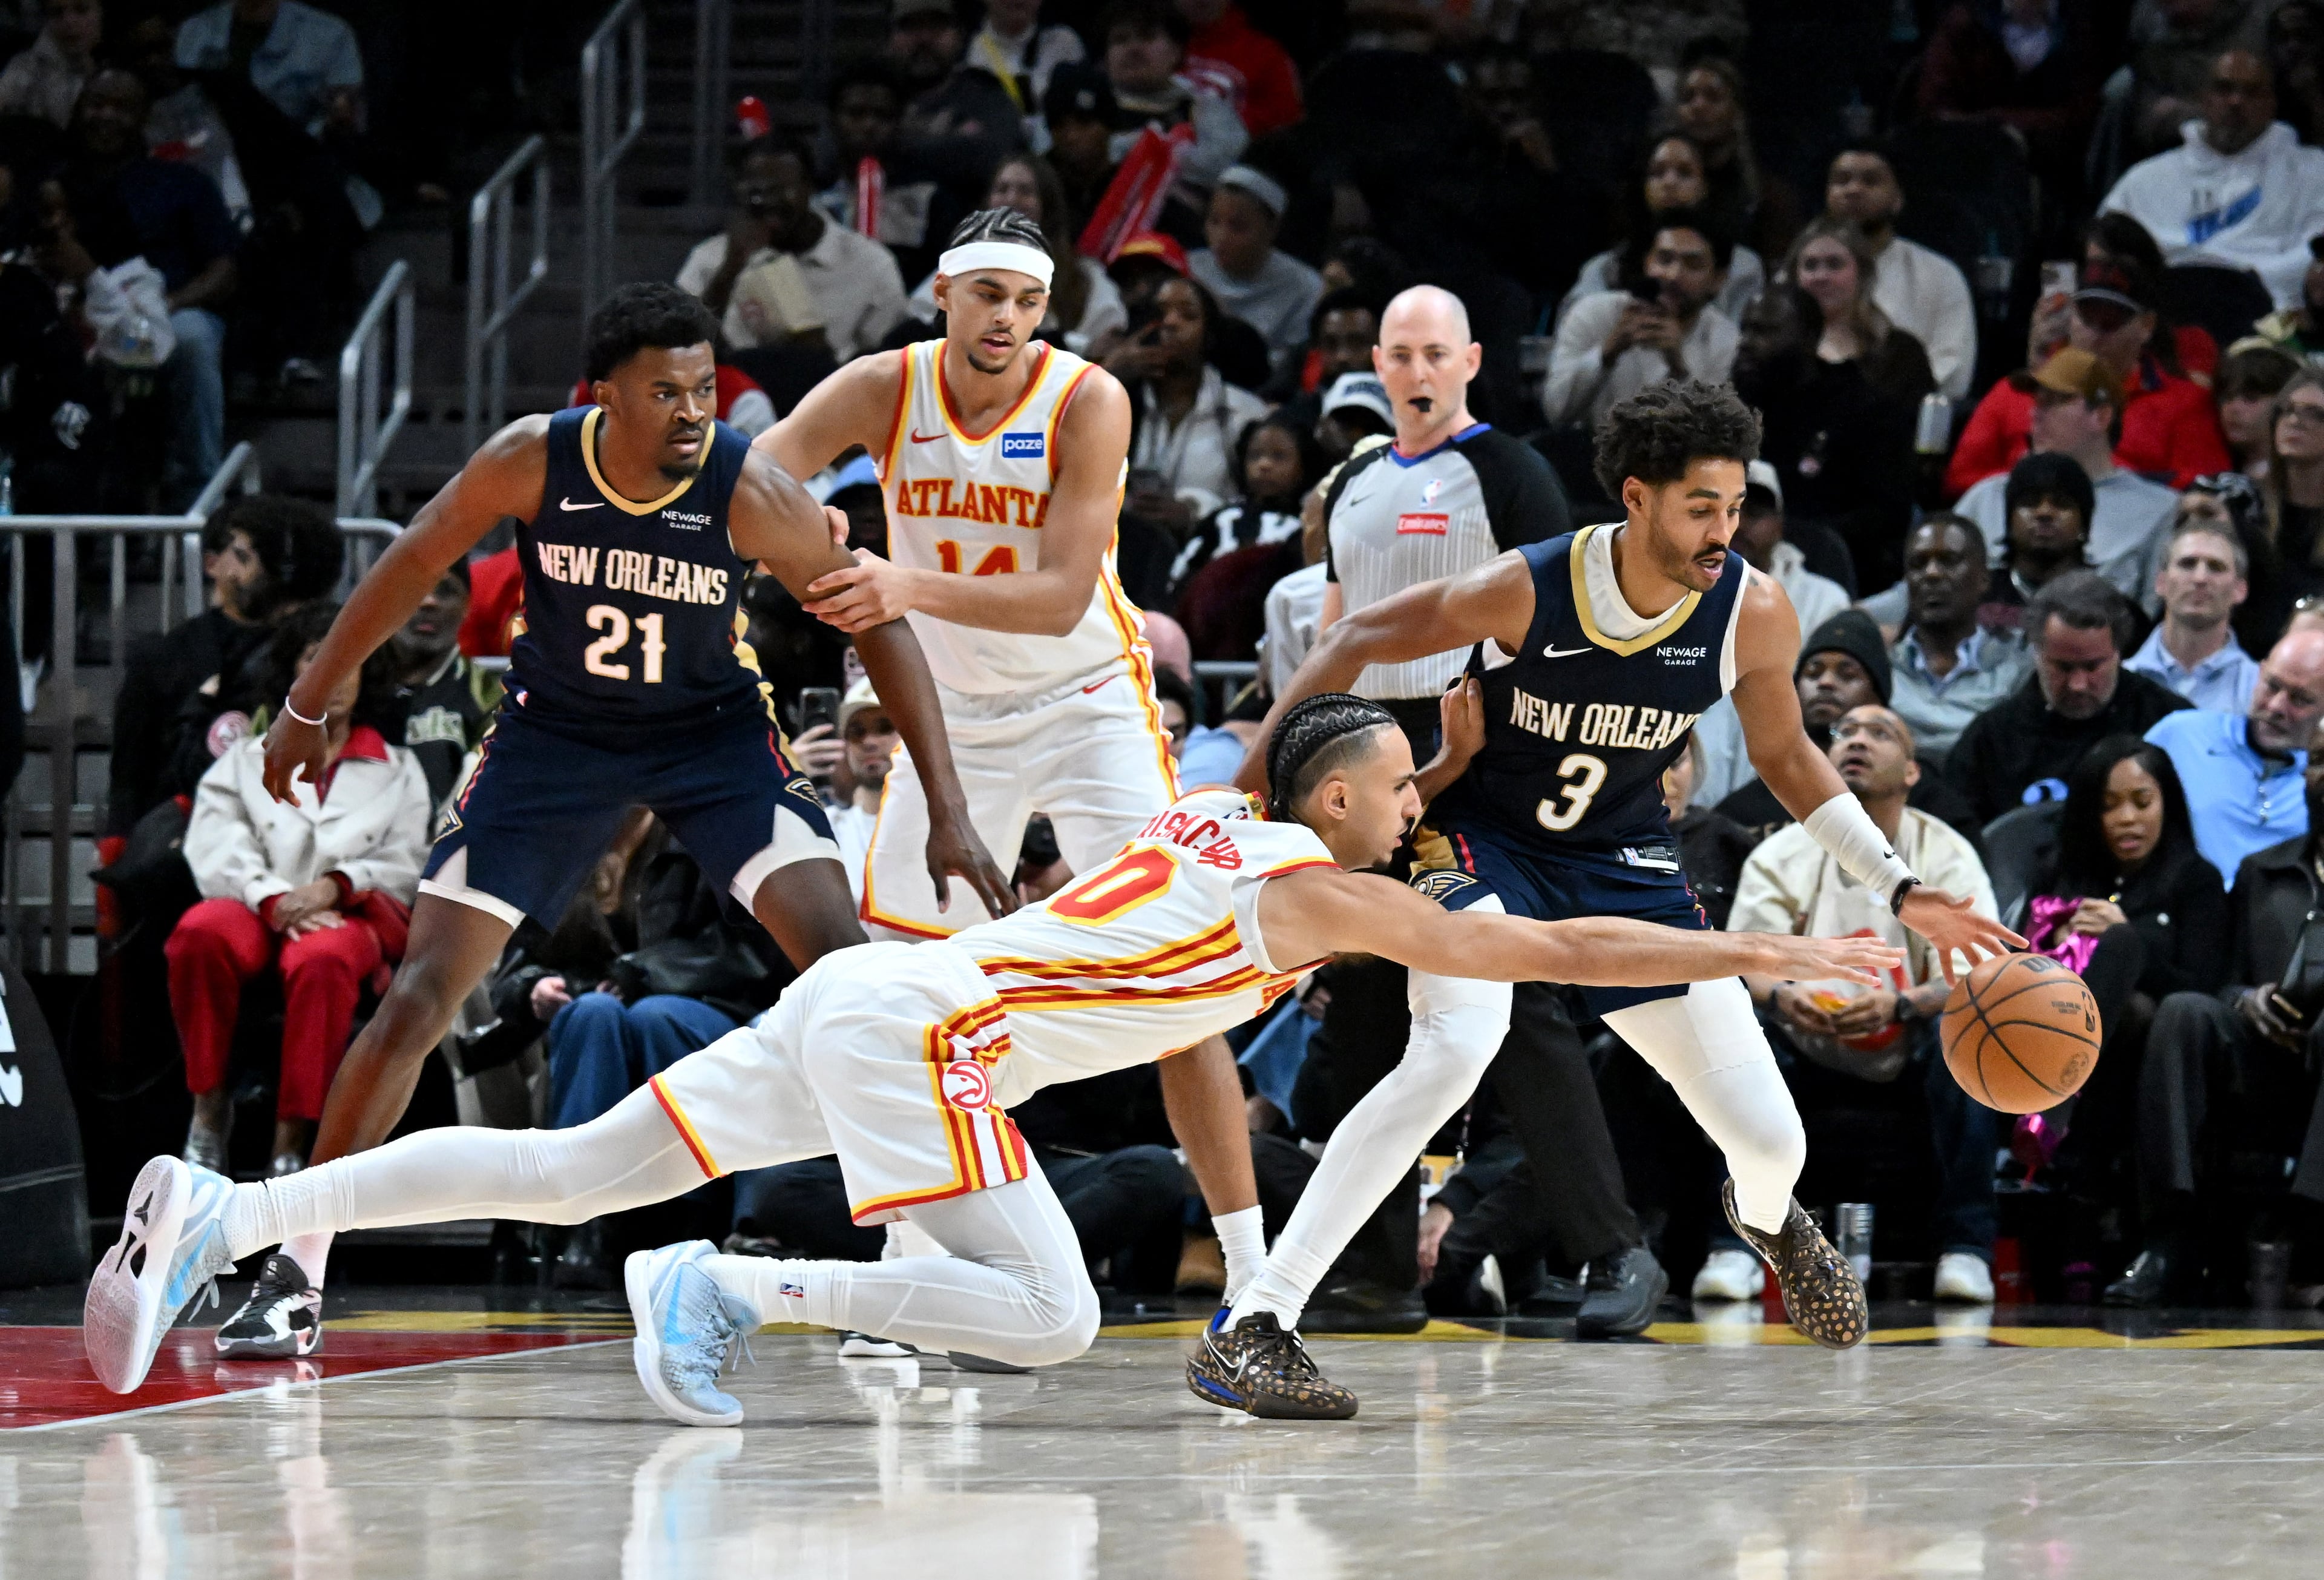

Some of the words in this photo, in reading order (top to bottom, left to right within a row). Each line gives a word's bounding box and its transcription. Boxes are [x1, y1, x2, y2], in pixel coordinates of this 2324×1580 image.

[1004, 437, 1043, 453] paze
[661, 510, 712, 526] NEWAGE
[669, 522, 702, 532] GARAGE
[897, 478, 1050, 528] ATLANTA
[537, 542, 599, 585] NEW
[605, 548, 728, 605] ORLEANS
[585, 604, 666, 683] 21
[1656, 647, 1707, 658] NEWAGE
[1509, 686, 1576, 742] NEW
[1535, 753, 1608, 832] 3
